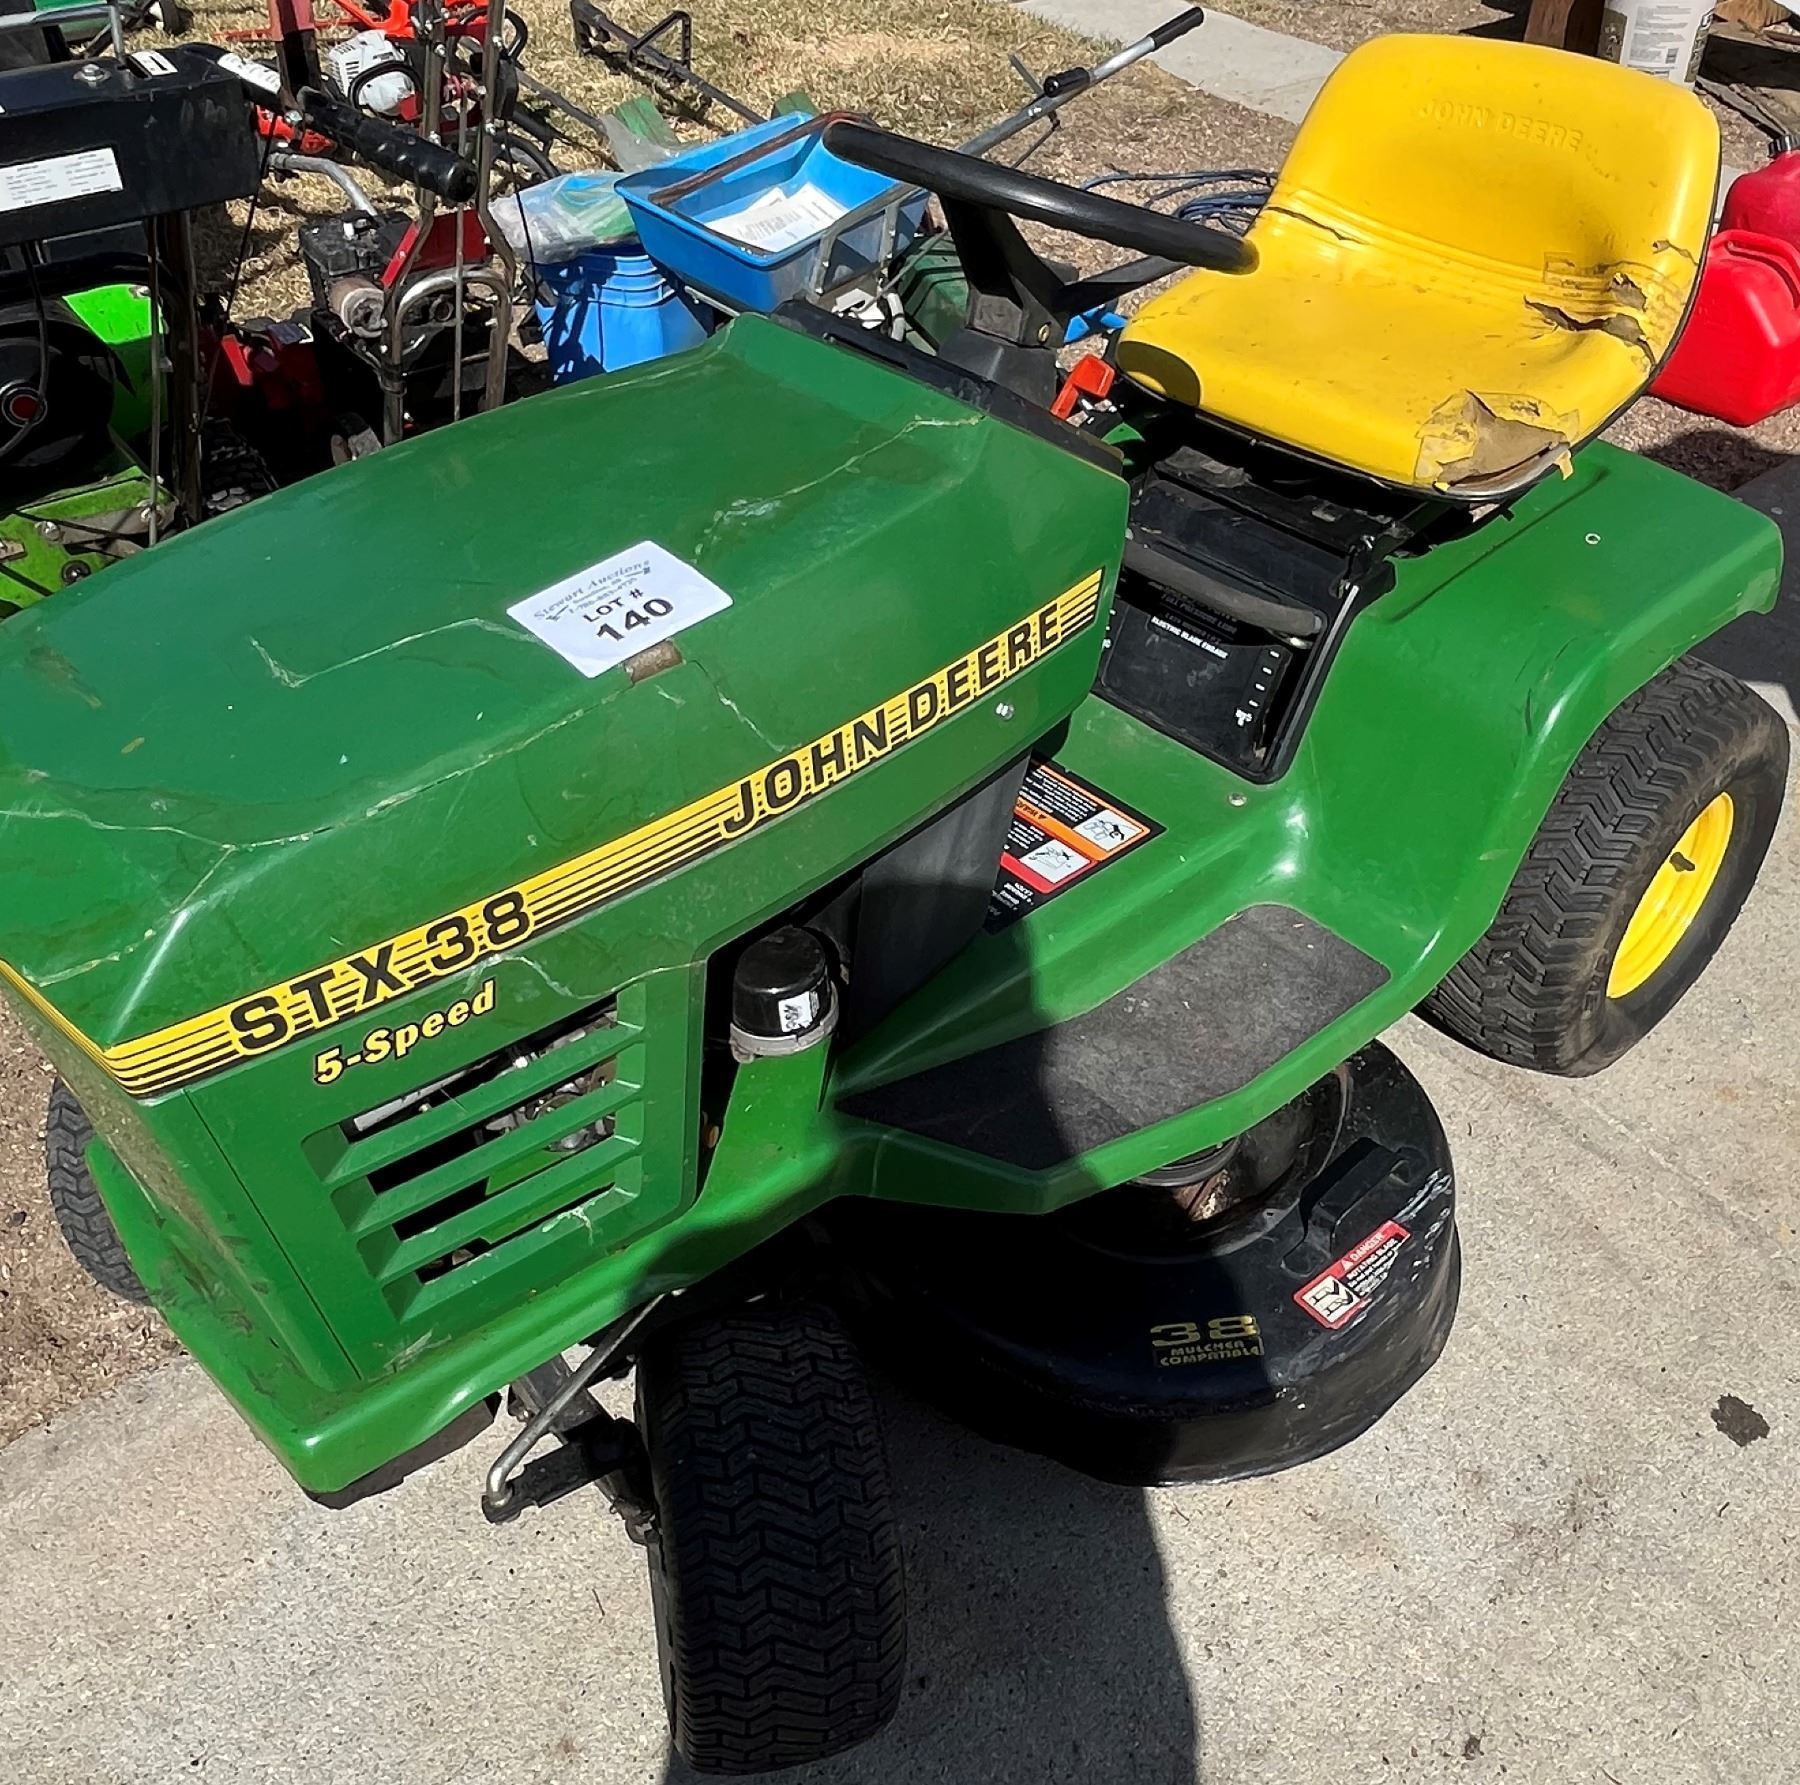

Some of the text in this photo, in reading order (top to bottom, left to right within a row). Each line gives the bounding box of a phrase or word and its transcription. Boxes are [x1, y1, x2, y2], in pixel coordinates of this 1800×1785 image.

[1418, 98, 1584, 153] JOHN DEERE
[583, 597, 622, 623] LOT
[629, 588, 644, 599] #
[596, 598, 674, 642] 140
[723, 708, 888, 833] JOHN
[908, 602, 1063, 734] DEERE
[229, 890, 531, 1050] STX 38
[313, 976, 497, 1085] 5-Speed
[1149, 1314, 1261, 1347] 38
[1170, 1339, 1245, 1356] MULCHER
